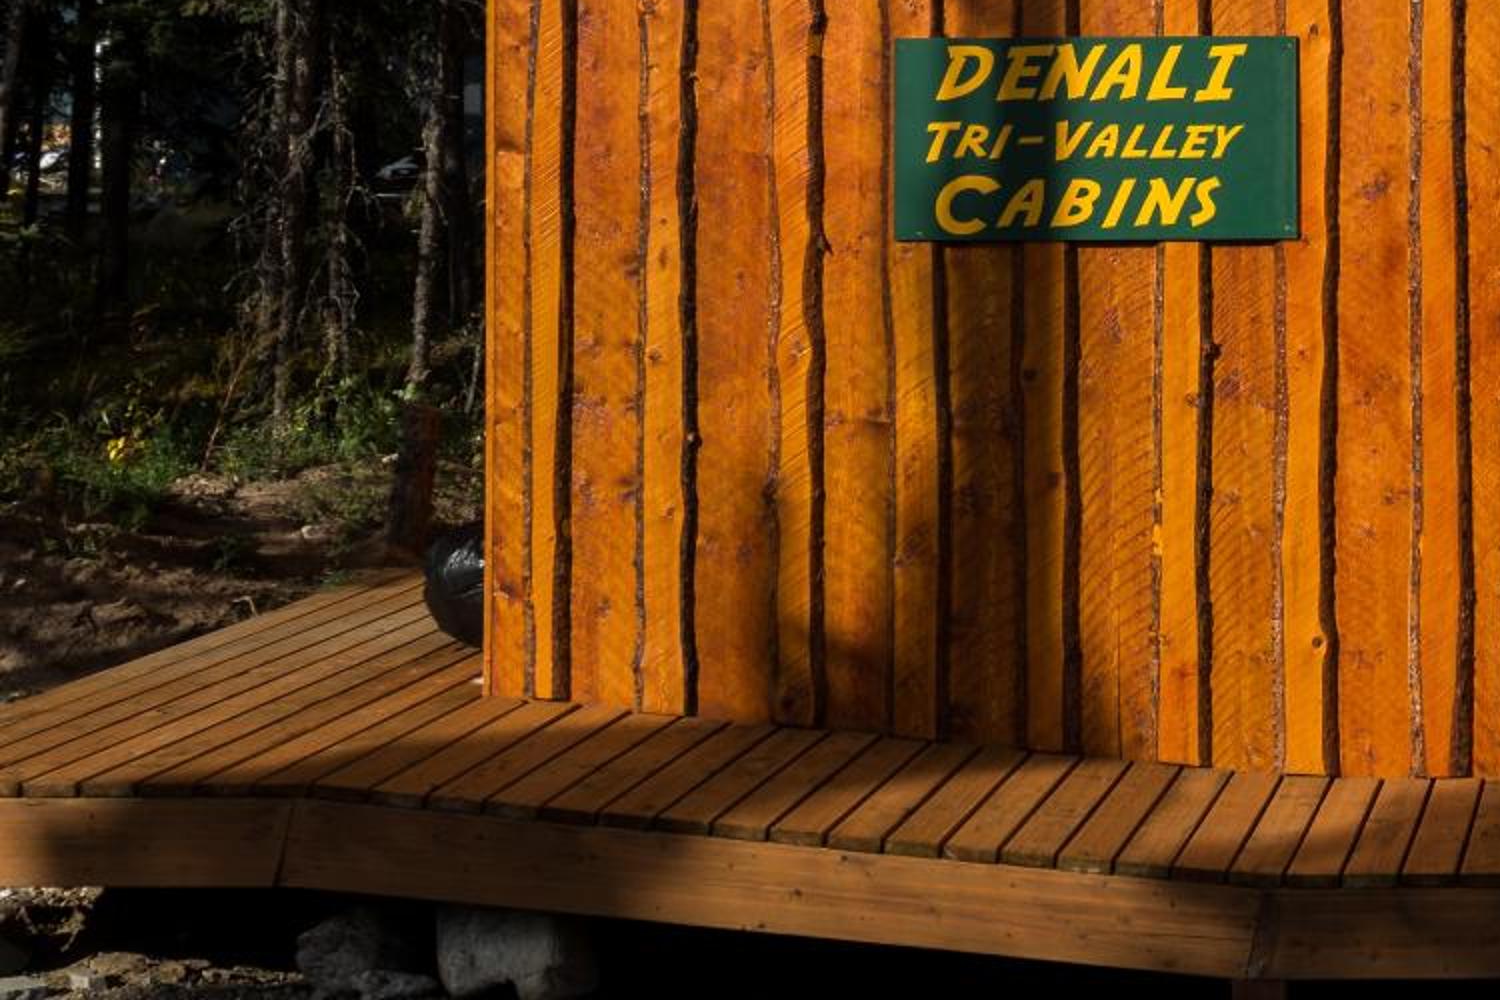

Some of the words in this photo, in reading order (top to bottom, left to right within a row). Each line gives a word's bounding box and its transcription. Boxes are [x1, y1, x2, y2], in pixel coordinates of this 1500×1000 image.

[935, 43, 1249, 102] DENALI
[926, 120, 1244, 164] TRI-VALLEY
[934, 175, 1223, 235] CABINS
